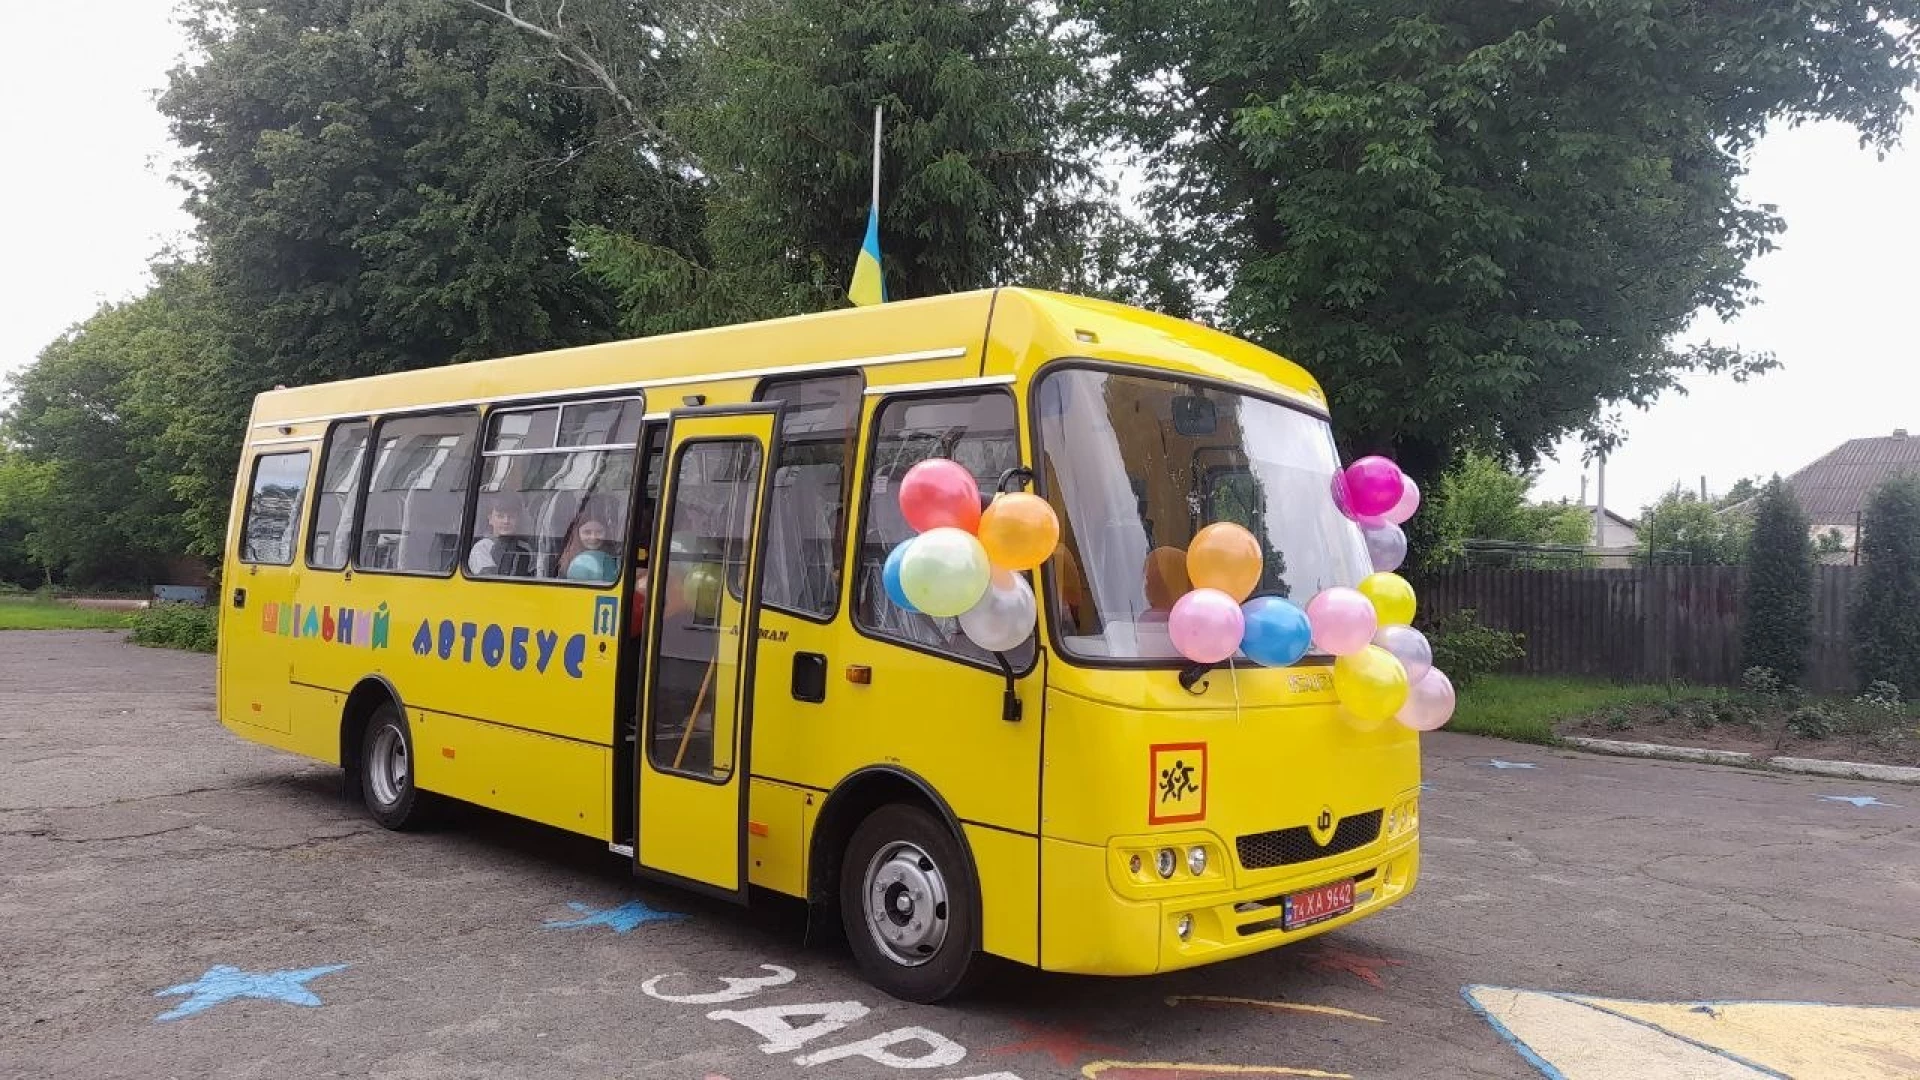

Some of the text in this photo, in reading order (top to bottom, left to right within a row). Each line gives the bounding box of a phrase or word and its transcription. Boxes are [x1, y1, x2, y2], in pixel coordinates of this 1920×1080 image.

[263, 601, 586, 678] ШКІЛЬНИЙ АВТОБУС
[729, 625, 789, 642] AMAN
[1327, 884, 1351, 910] 9642
[641, 963, 1030, 1080] ЗДР
